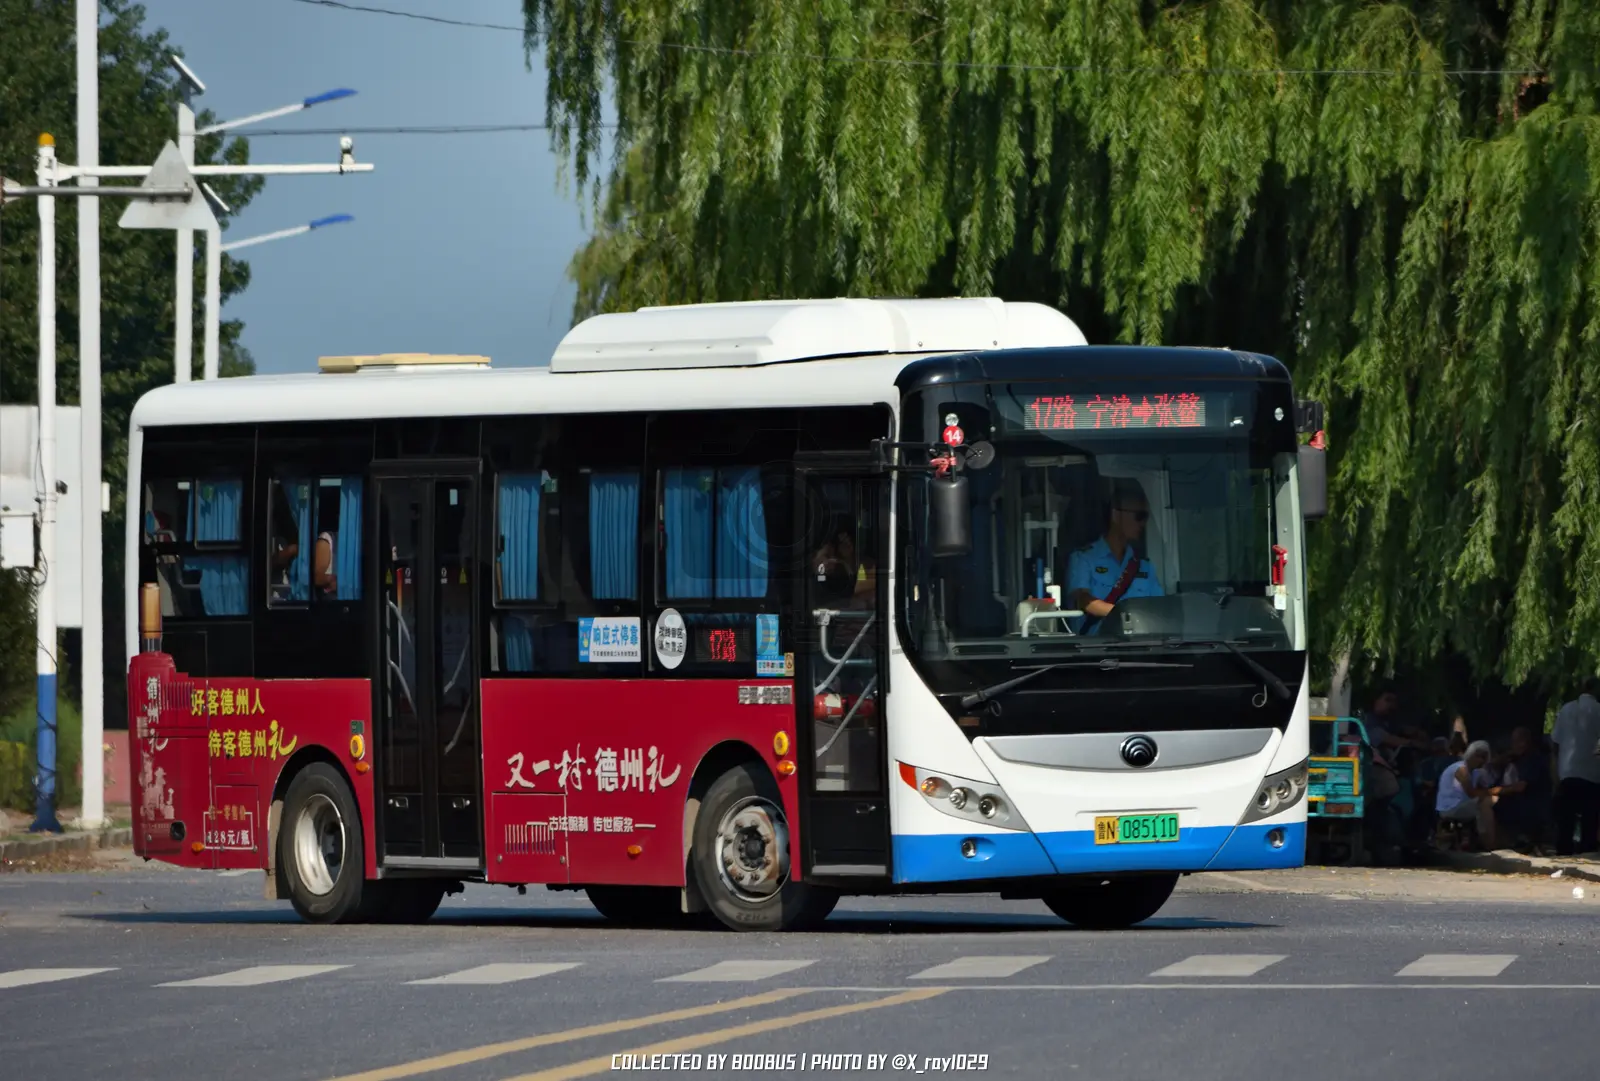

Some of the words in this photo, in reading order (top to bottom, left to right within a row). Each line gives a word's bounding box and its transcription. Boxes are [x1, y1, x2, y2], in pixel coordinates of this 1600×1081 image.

[1031, 395, 1078, 429] 17路
[1086, 394, 1132, 429] 宁津
[946, 429, 961, 442] 14
[190, 687, 266, 717] 好客德州人
[208, 719, 298, 761] 待客德州礼
